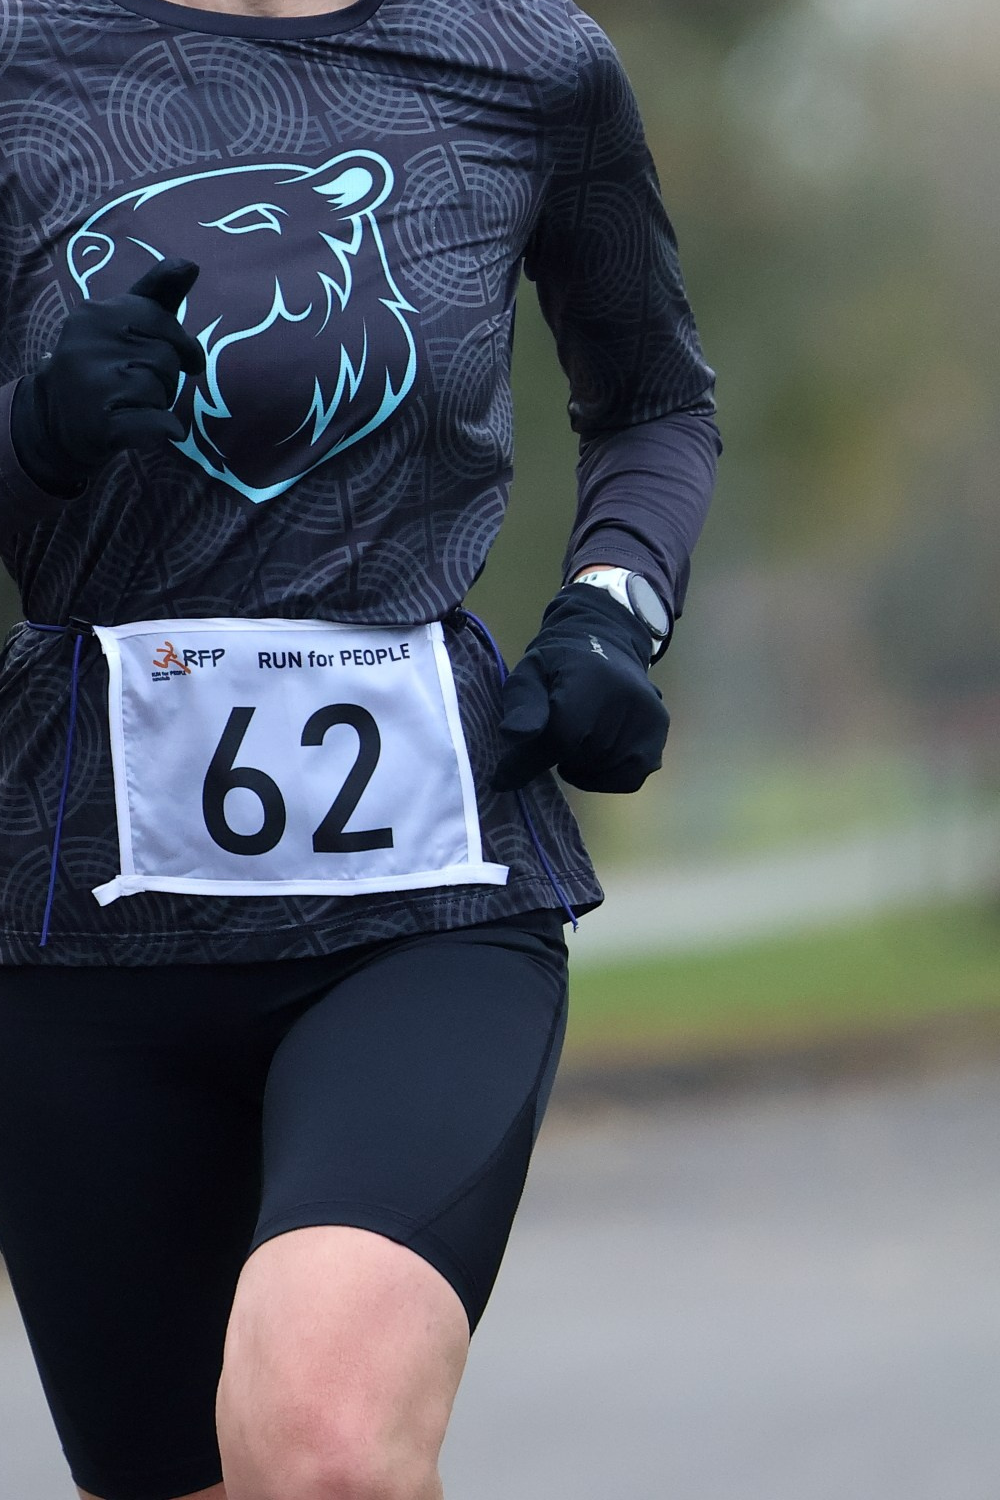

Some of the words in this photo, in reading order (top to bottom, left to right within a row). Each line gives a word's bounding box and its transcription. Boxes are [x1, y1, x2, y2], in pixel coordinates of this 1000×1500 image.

[182, 648, 226, 668] RFP
[257, 650, 303, 669] RUN
[307, 650, 335, 668] for
[339, 643, 411, 667] PEOPLE
[201, 703, 394, 857] 62
